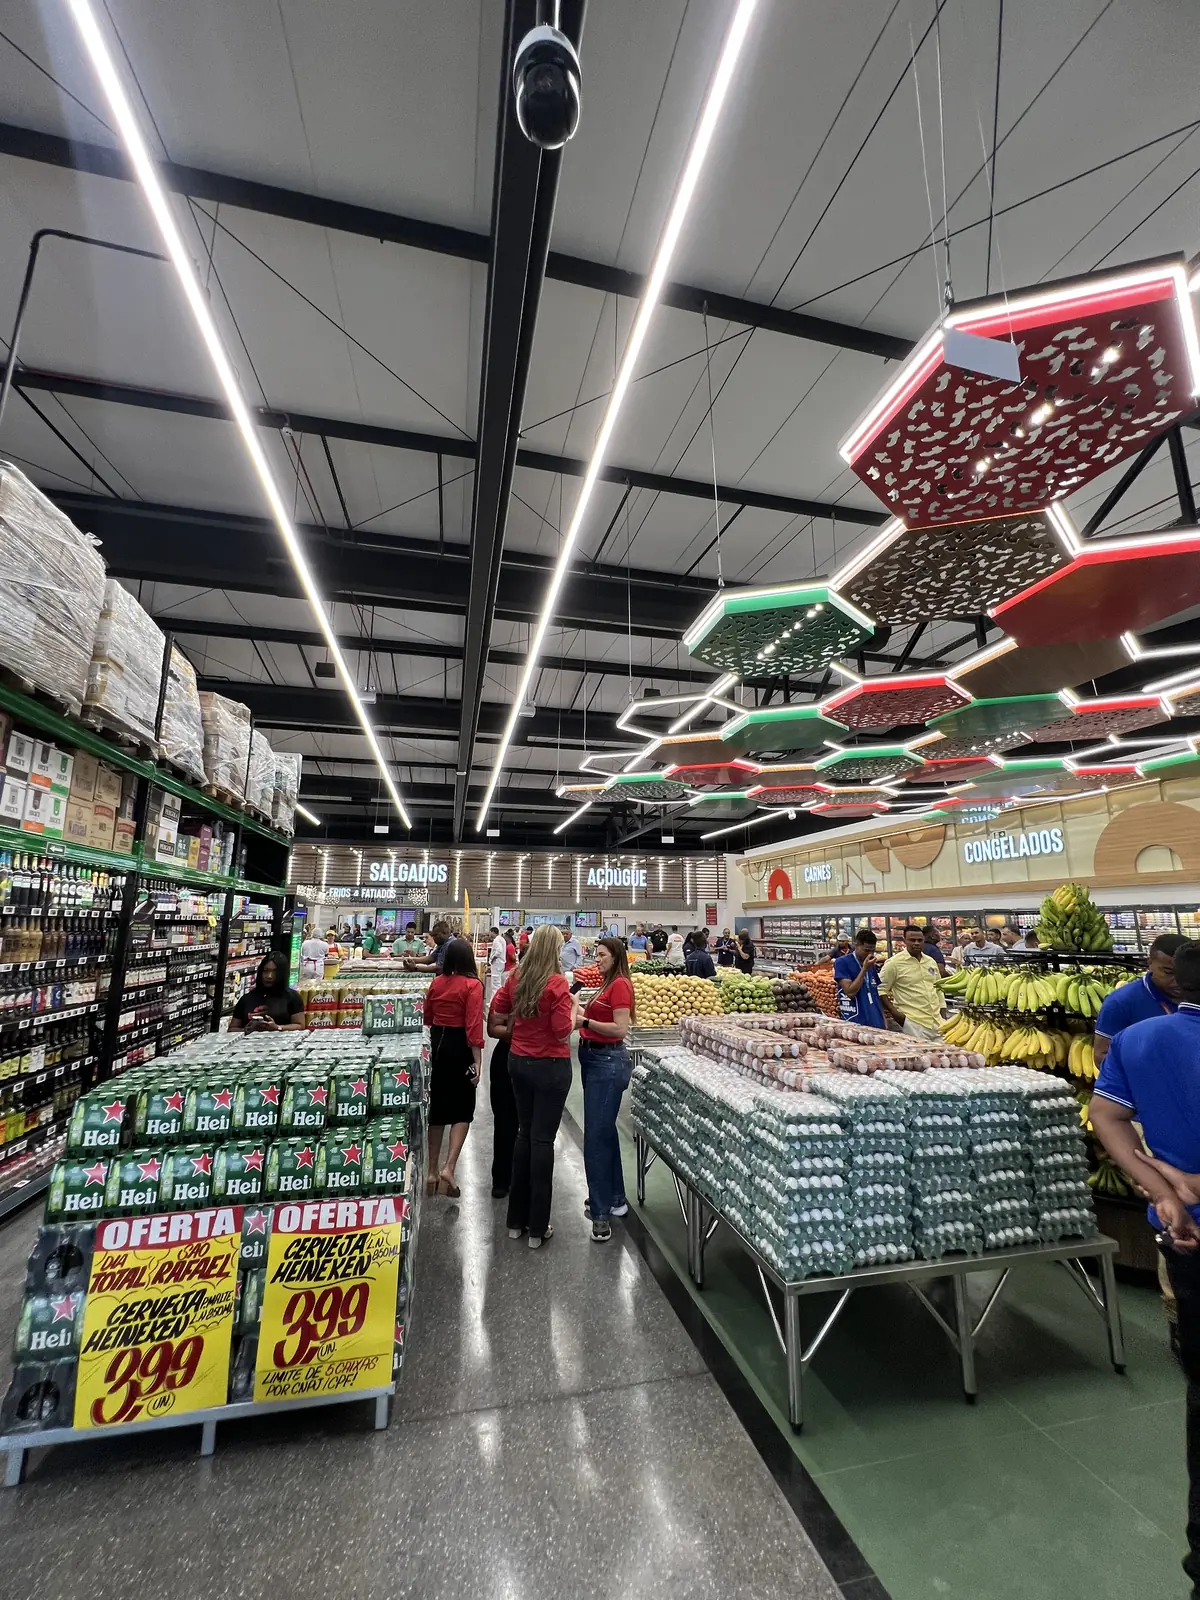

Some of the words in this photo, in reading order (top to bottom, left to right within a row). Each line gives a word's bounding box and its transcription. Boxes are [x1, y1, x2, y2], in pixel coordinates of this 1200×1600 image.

[964, 828, 1064, 864] CONGELADOS
[370, 862, 448, 883] SALGADOS
[587, 867, 647, 889] AÇOUGUE
[804, 864, 831, 883] CARNES
[329, 887, 351, 897] FRIOS
[361, 888, 396, 898] FATIADOS
[102, 1208, 236, 1250] OFERTA
[277, 1199, 396, 1233] OFERTA
[283, 1232, 370, 1261] CERVEJA
[101, 1253, 128, 1271] DIA
[151, 1254, 231, 1285] RAFAEL
[270, 1254, 372, 1284] HEINEKEN
[89, 1265, 148, 1294] TOTAL
[107, 1288, 207, 1326] CERVEJA
[81, 1314, 190, 1354] HEINEKEN
[272, 1282, 370, 1370] 3,99
[262, 1368, 302, 1385] LIMITE
[305, 1365, 322, 1380] DE
[334, 1356, 379, 1375] CAIXAS
[266, 1383, 291, 1397] POR
